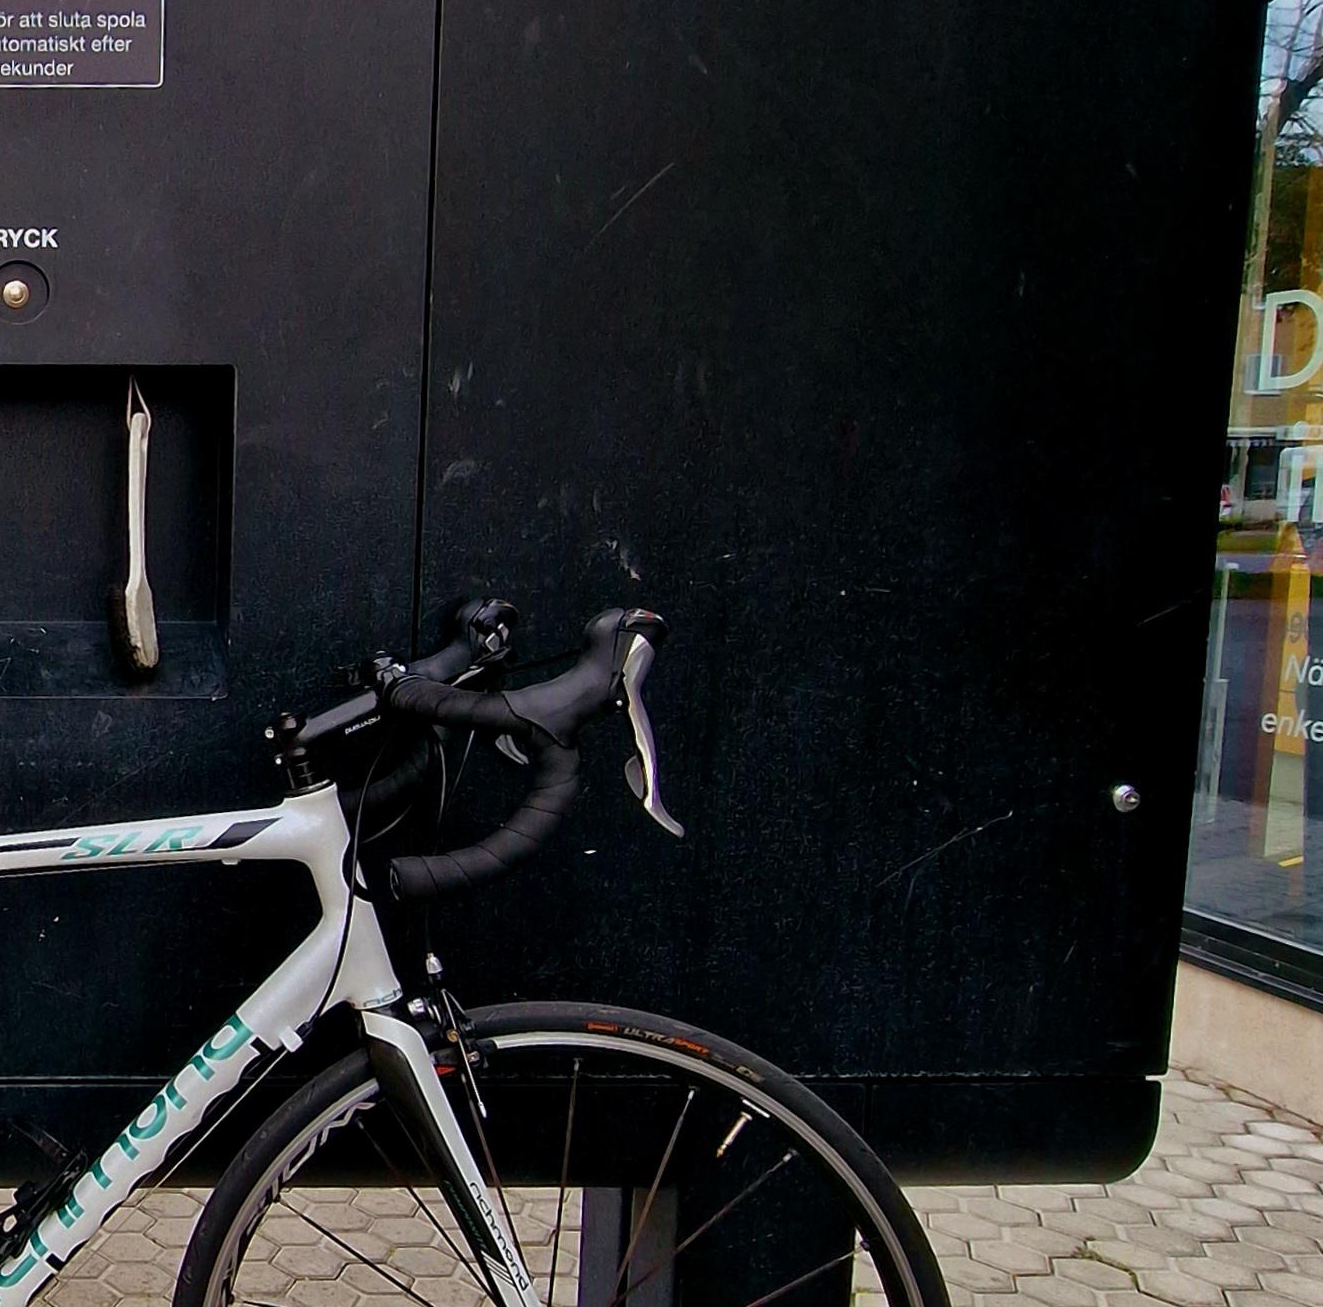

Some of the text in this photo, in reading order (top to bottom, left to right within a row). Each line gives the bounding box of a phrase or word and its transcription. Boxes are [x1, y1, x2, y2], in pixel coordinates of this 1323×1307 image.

[19, 11, 43, 28] att
[48, 10, 92, 30] sluta
[96, 10, 146, 32] spola
[90, 34, 133, 53] efter
[62, 825, 204, 860] SLR
[469, 1181, 529, 1292] richmond
